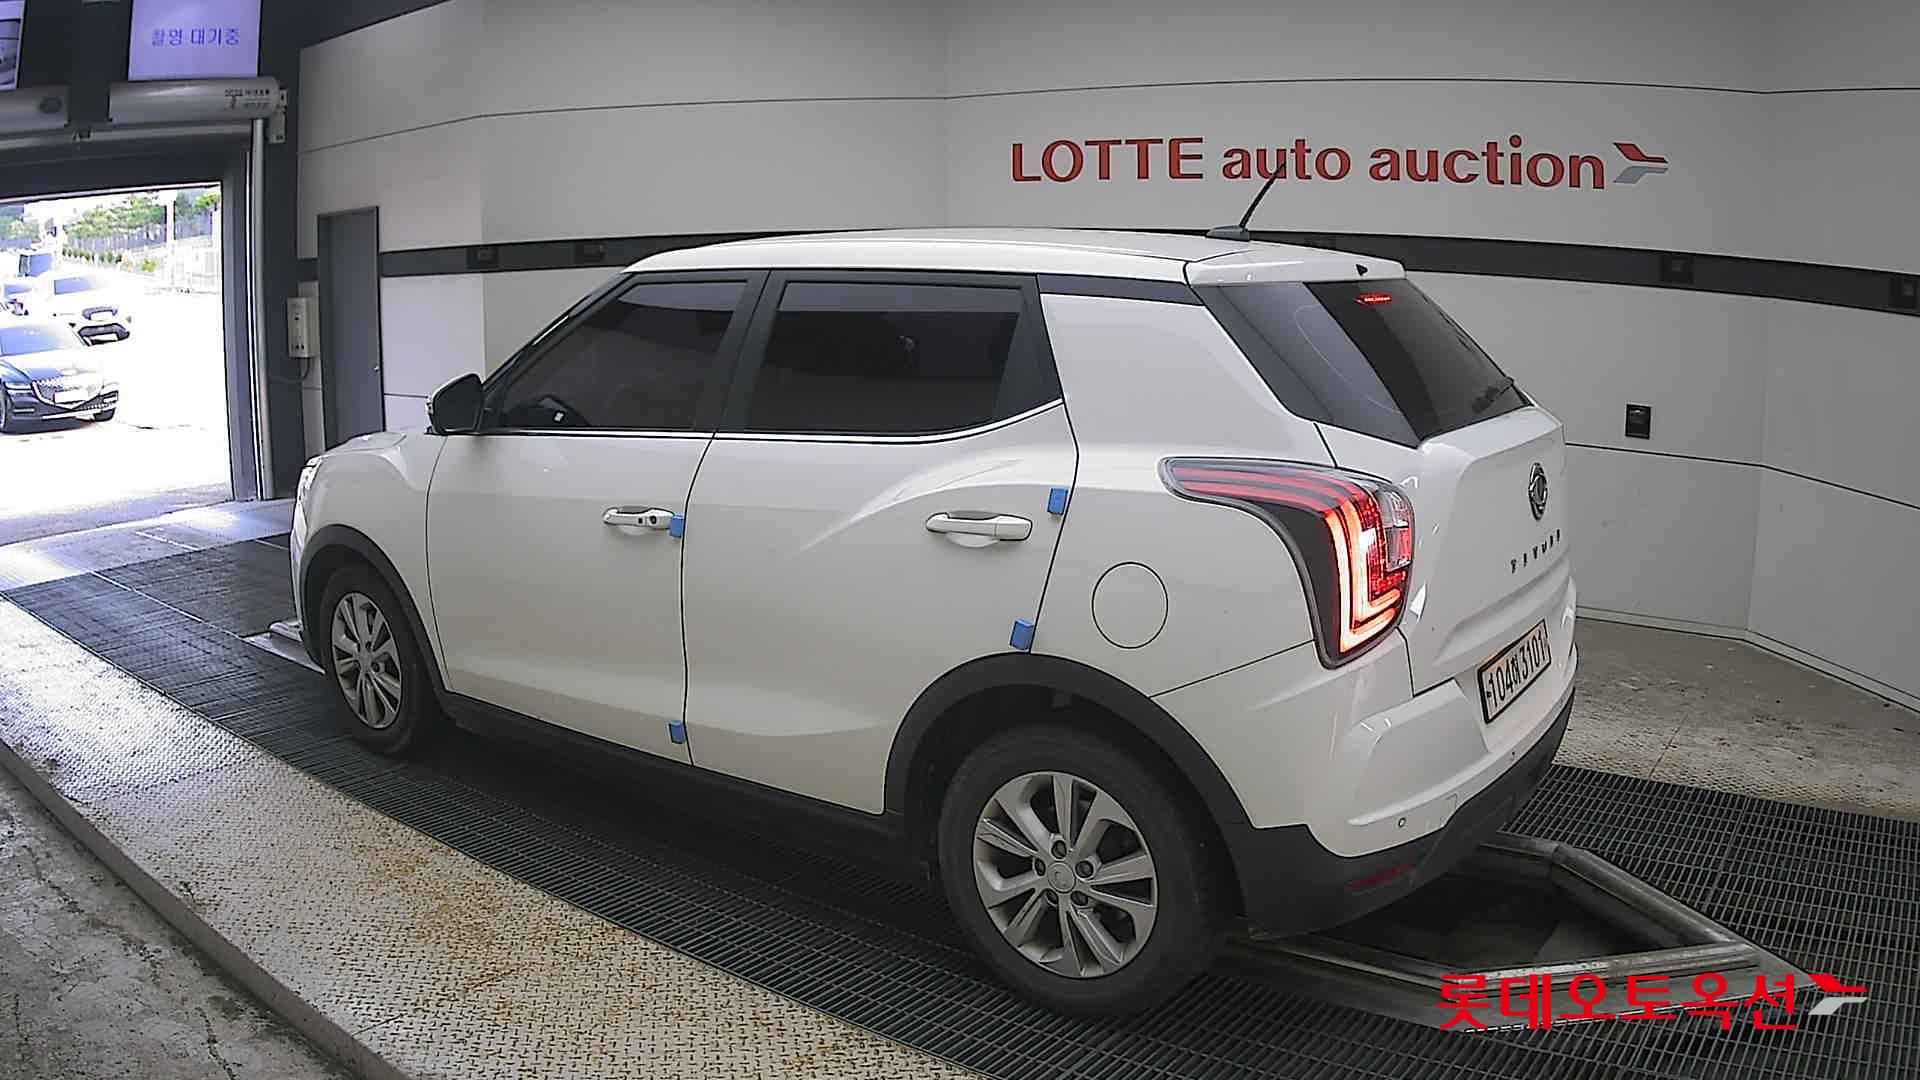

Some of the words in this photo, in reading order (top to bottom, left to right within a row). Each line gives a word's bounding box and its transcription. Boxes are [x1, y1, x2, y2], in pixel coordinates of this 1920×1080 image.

[191, 27, 240, 46] 대기중
[1012, 137, 1204, 183] LOTTE
[1222, 138, 1351, 181] auto
[1369, 135, 1605, 189] auction
